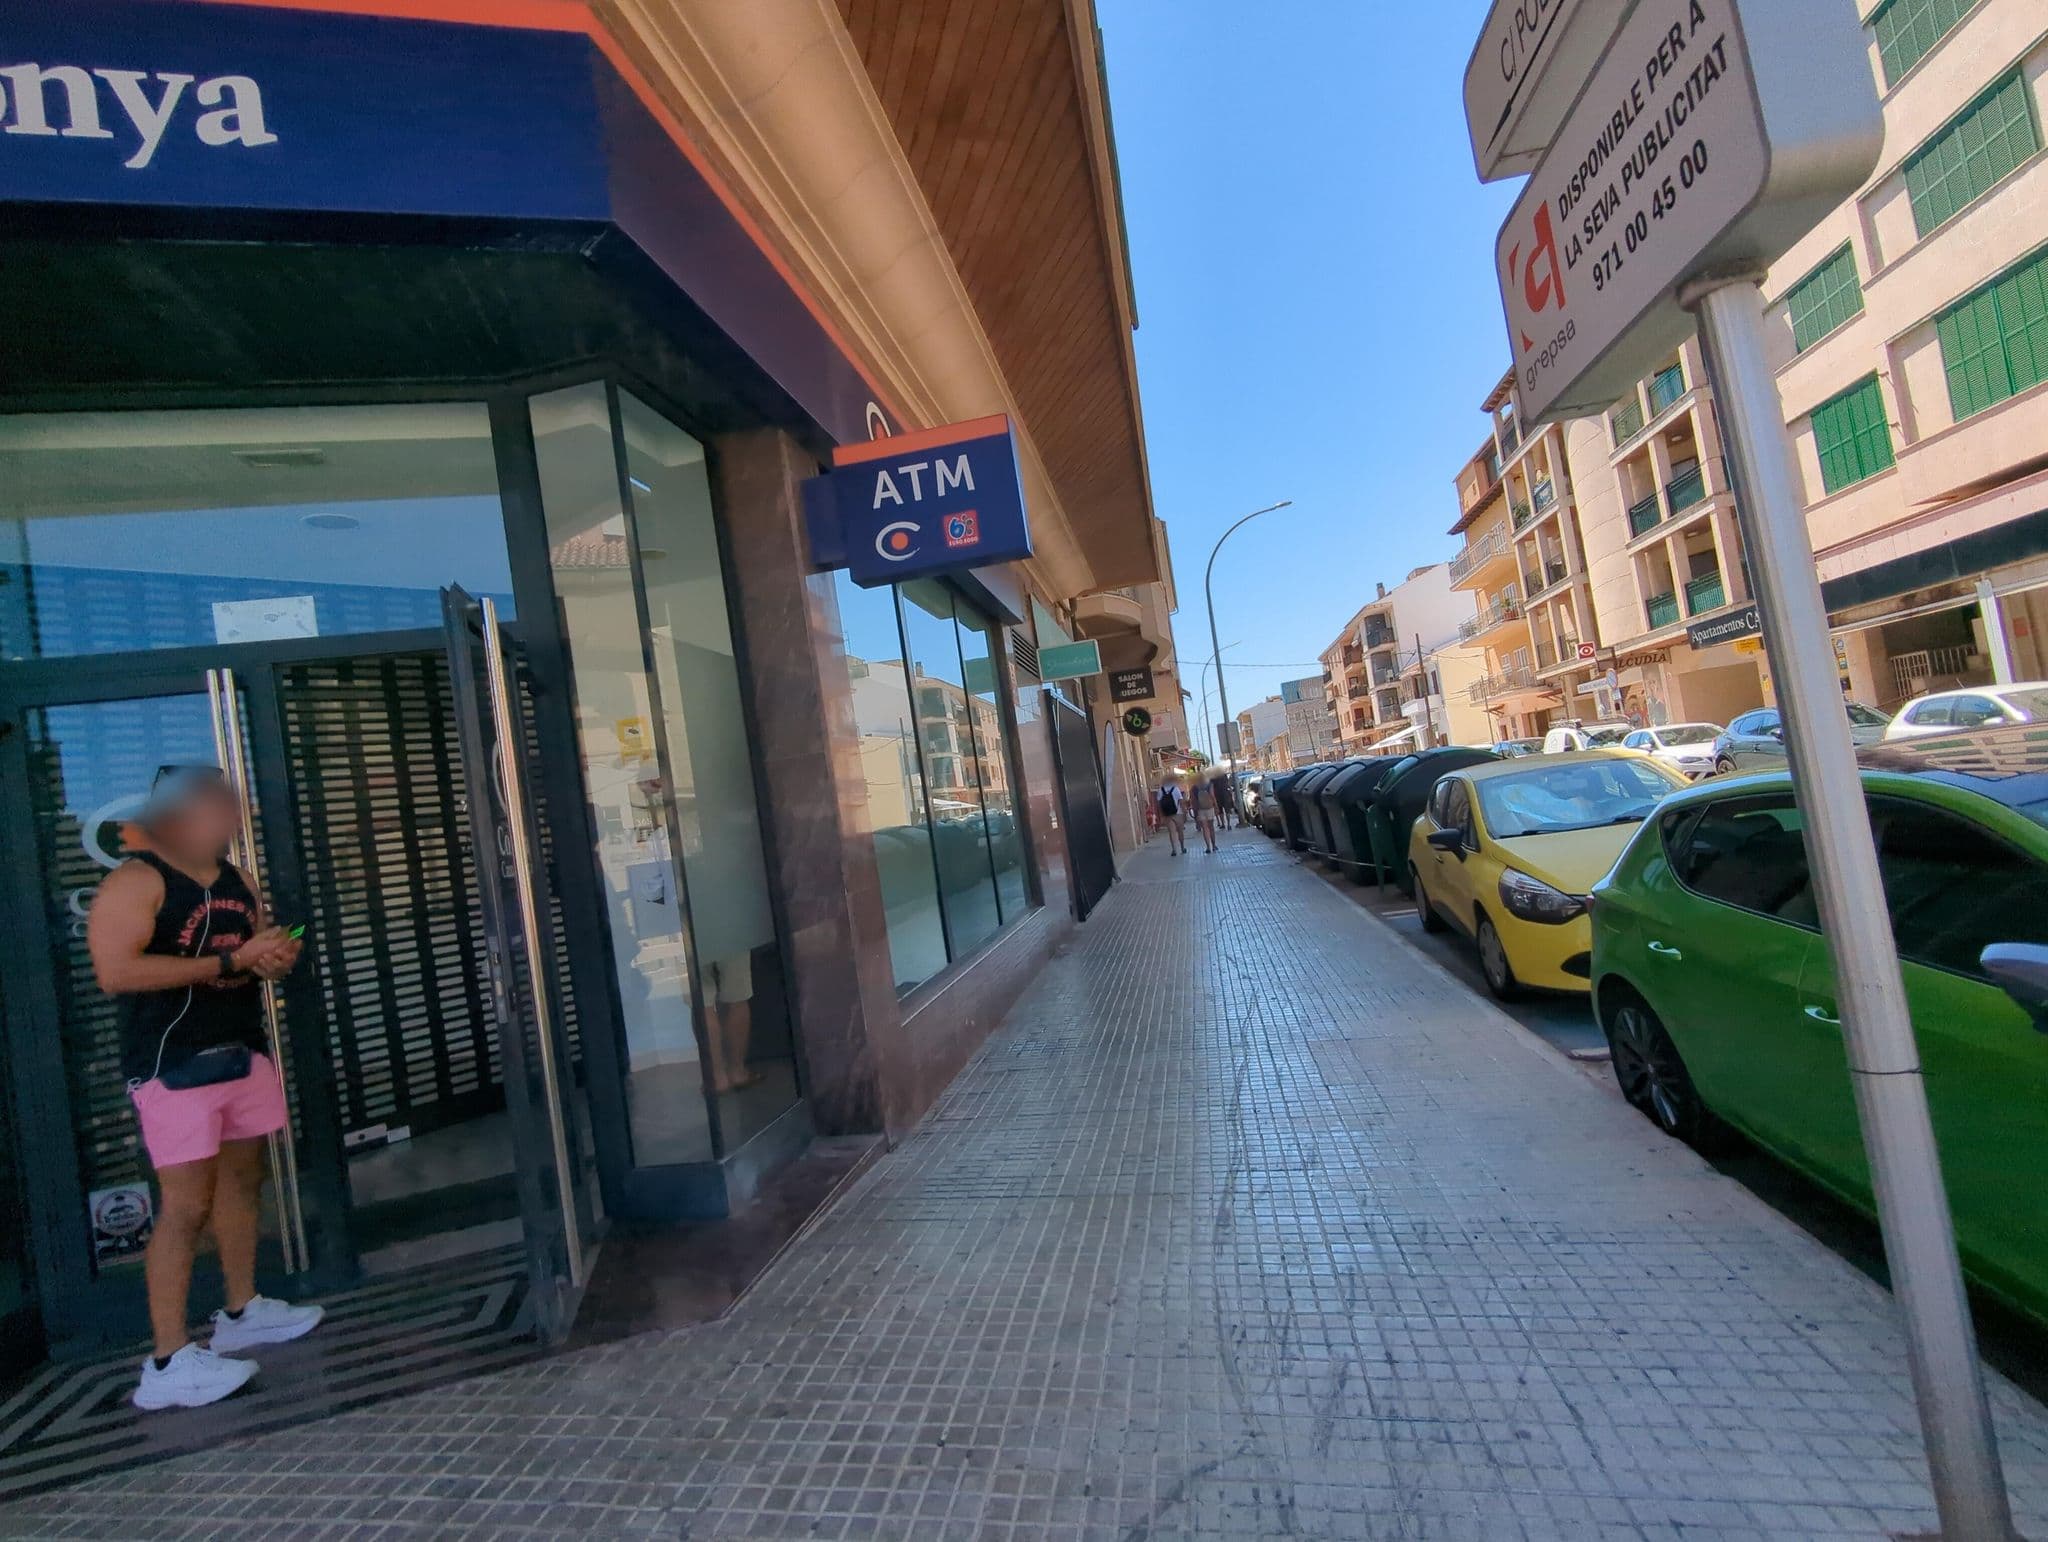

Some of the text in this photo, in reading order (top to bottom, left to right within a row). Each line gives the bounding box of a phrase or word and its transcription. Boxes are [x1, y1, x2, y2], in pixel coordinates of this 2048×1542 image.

[1515, 0, 1550, 54] PO
[0, 62, 279, 169] nya
[1558, 0, 1705, 222] DISPONIBLE PER A
[1564, 32, 1728, 270] LA SEVA PUBLICITAT
[1593, 138, 1708, 291] 971 00 45 00
[1526, 317, 1576, 392] grepsa
[872, 454, 976, 510] ATM
[1691, 618, 1745, 644] Apartamentos
[1118, 672, 1143, 682] SALON
[1126, 681, 1137, 689] DE
[1617, 652, 1667, 669] LCUDIA
[1120, 687, 1148, 697] UEGOS
